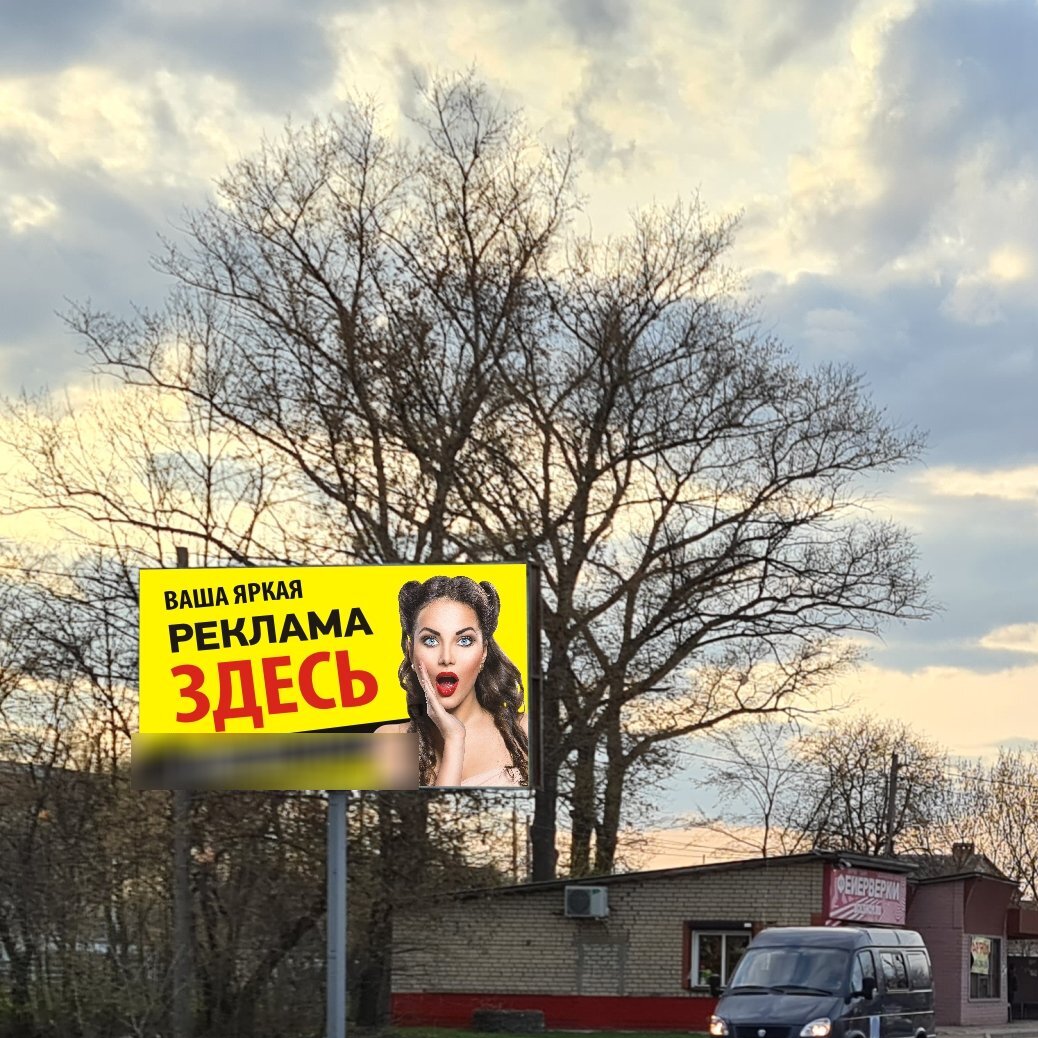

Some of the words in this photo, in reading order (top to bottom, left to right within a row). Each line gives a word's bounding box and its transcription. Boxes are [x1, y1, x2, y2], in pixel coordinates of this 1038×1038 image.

[164, 587, 229, 611] ВАША
[233, 579, 303, 605] ЯРКАЯ
[168, 607, 374, 653] РЕКЛАМА
[171, 650, 379, 732] ЗДЕСЬ
